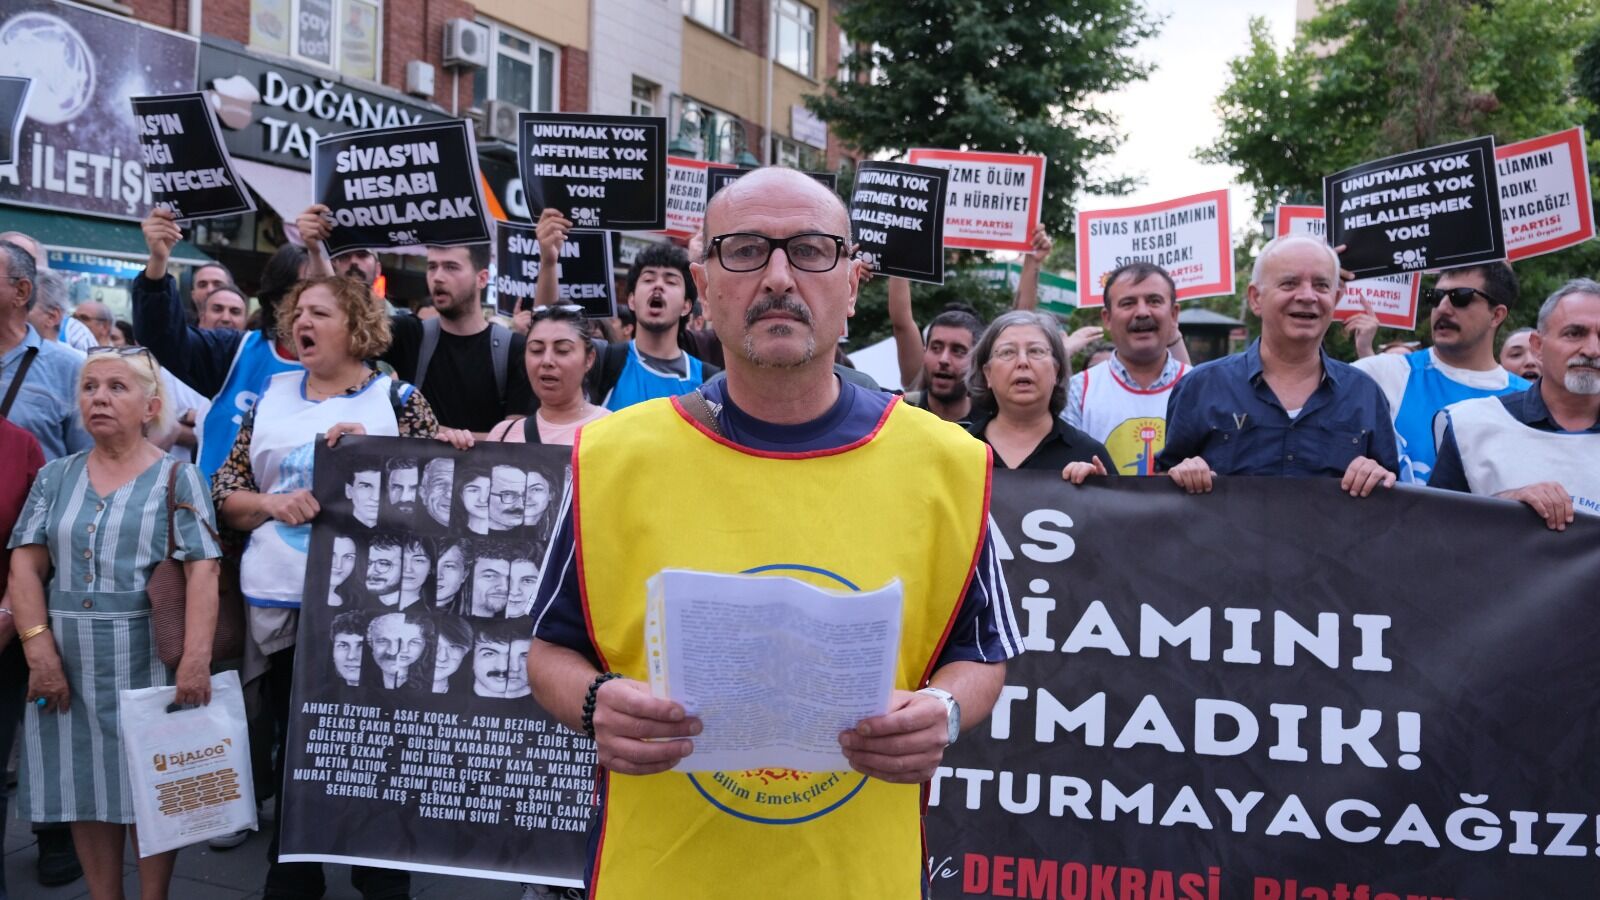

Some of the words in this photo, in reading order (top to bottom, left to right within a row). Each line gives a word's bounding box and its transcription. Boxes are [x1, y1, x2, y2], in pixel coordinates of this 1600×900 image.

[533, 124, 608, 140] UNUTMAK
[611, 128, 646, 141] YOK
[335, 141, 440, 173] SİVAS'IN
[531, 144, 610, 159] AFFETMEK
[613, 147, 648, 161] YOK
[1499, 151, 1553, 176] LİAMINI
[149, 167, 232, 193] EYECEK
[343, 171, 438, 201] HESABI
[534, 164, 644, 182] HELALLEŞMEK
[674, 170, 707, 185] KATLİA
[902, 176, 930, 192] YOK
[988, 166, 1025, 187] ÖLÜM
[1342, 163, 1426, 193] UNUTMAK
[1429, 154, 1470, 173] YOK
[566, 184, 605, 198] YOK!
[670, 184, 702, 198] HESABI
[964, 190, 1029, 212] HÜRRİYET
[1340, 183, 1430, 213] AFFETMEK
[1434, 174, 1475, 194] YOK
[1501, 178, 1538, 199] ADIK!
[321, 196, 477, 228] SORULACAK
[900, 196, 928, 212] YOK
[1344, 196, 1473, 231] HELALLEŞMEK
[1502, 192, 1571, 222] AYACAĞIZ!
[1090, 221, 1129, 236] SİVAS
[1134, 205, 1216, 233] KATLİAMININ
[1385, 223, 1430, 242] YOK!
[1511, 214, 1561, 234] PARTİSİ
[859, 228, 887, 245] YOK!
[1132, 232, 1177, 251] HESABI
[1021, 578, 1392, 672] İAMINI
[302, 702, 340, 714] AHMET
[343, 703, 381, 718] ÖZYURT
[394, 709, 420, 722] ASAF
[423, 712, 459, 727] KOÇAK
[472, 716, 500, 729] ASIM
[504, 718, 546, 733] BEZİRCİ
[991, 685, 1421, 770] TMADIK!
[309, 728, 364, 744] GÜLENDER
[367, 735, 394, 750] AKÇA
[408, 737, 450, 752] GÜLSÜM
[454, 742, 512, 757] KARABABA
[525, 747, 570, 762] HANDAN
[318, 716, 356, 729] BELKIS
[359, 720, 391, 736] ÇAKIR
[394, 722, 433, 737] CARİNA
[438, 727, 481, 741] CUANNA
[537, 734, 568, 748] EDİBE
[306, 742, 346, 756] HURİYE
[350, 744, 384, 758] ÖZKAN
[401, 748, 423, 763] İNCİ
[428, 751, 454, 766] TÜRK
[467, 756, 502, 770] KORAY
[506, 759, 533, 772] KAYA
[547, 762, 593, 777] MEHMET
[293, 769, 332, 781] MURAT
[335, 770, 377, 785] GÜNDÜZ
[390, 776, 428, 790] NESİMİ
[432, 779, 466, 795] ÇİMEN
[480, 784, 524, 799] NURCAN
[315, 756, 348, 769] METİN
[352, 758, 388, 773] ALTIOK
[400, 763, 455, 779] MUAMMER
[460, 768, 491, 784] ÇİÇEK
[505, 773, 547, 787] MUHİBE
[551, 779, 595, 792] AKARSU
[713, 771, 750, 799] Bilim
[755, 772, 840, 804] Emekçileri
[326, 783, 378, 799] SEHERGÜL
[382, 788, 407, 805] ATEŞ
[420, 792, 461, 807] SERKAN
[465, 796, 502, 811] DOĞAN
[515, 800, 552, 816] SERPİL
[557, 804, 592, 819] CANİK
[419, 805, 465, 821] YASEMİN
[470, 809, 500, 825] SİVRİ
[514, 814, 547, 830] YEŞİM
[551, 816, 587, 832] ÖZKAN
